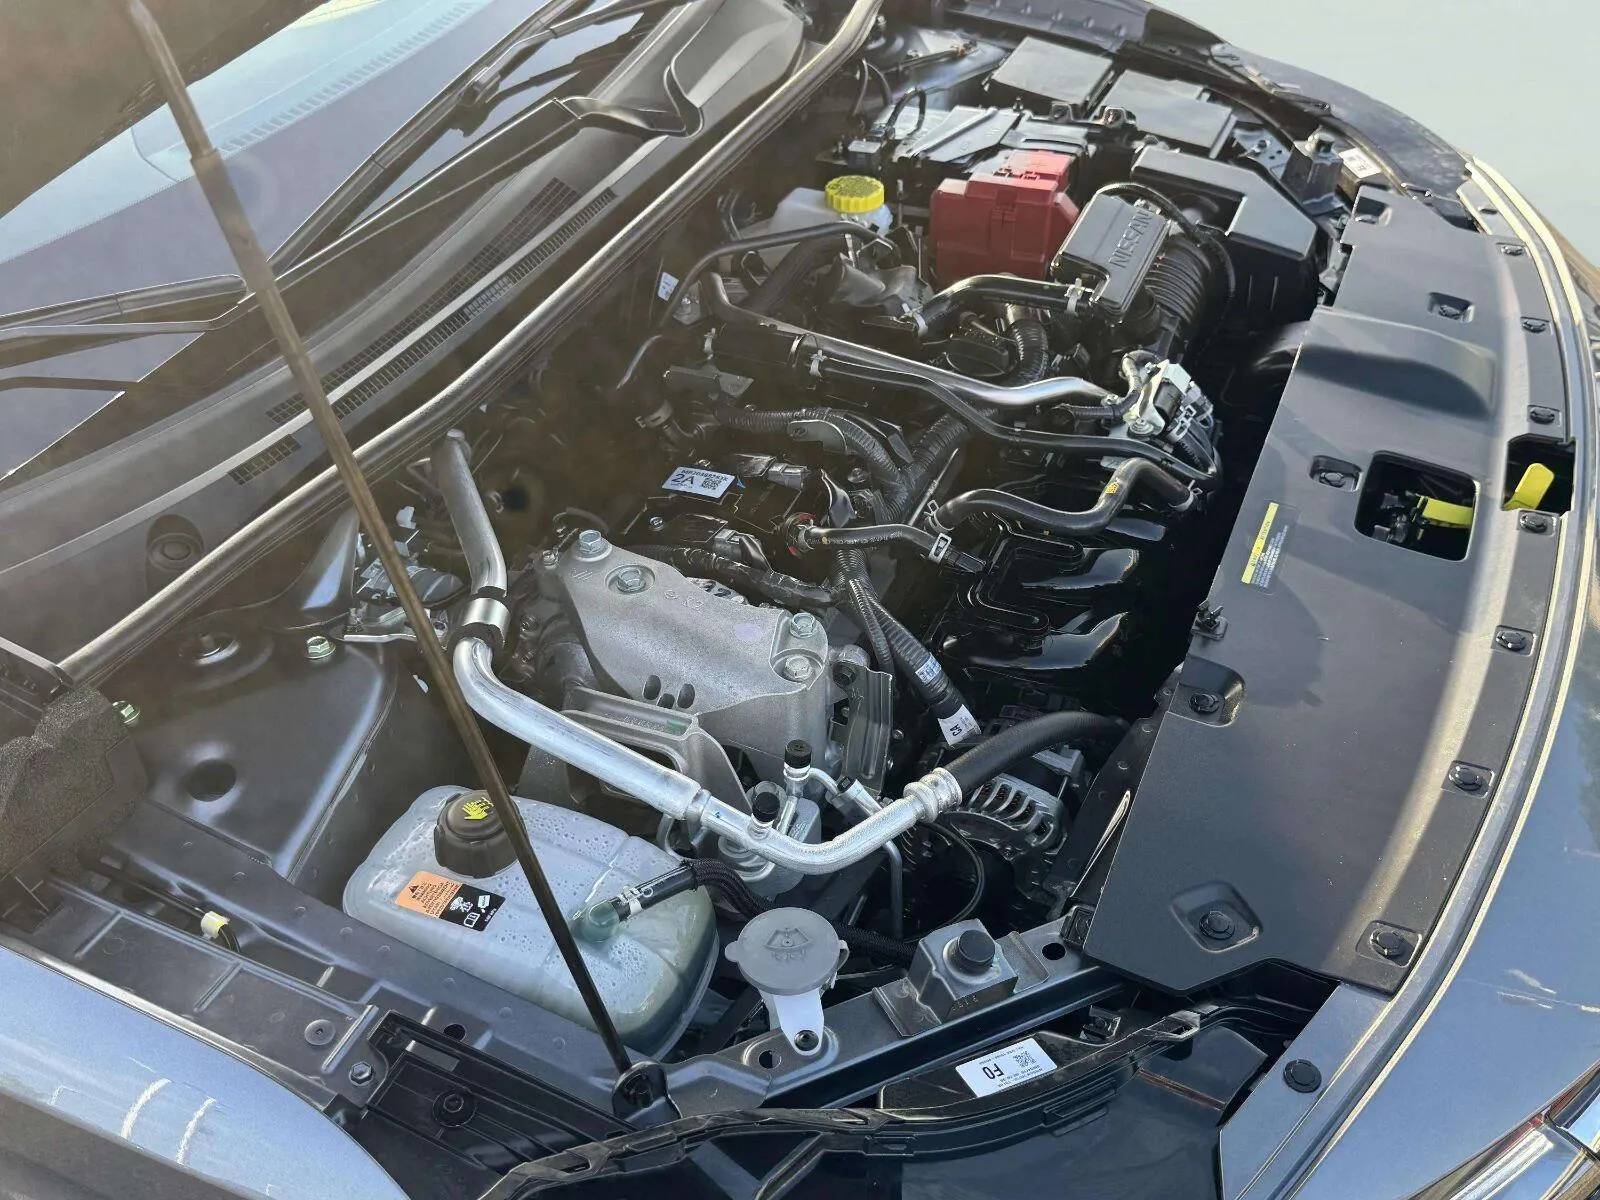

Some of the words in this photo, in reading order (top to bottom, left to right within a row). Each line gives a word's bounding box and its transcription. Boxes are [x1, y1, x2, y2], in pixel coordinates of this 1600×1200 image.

[1108, 209, 1153, 269] NISSAN
[672, 473, 694, 485] 2A
[949, 724, 963, 737] CA
